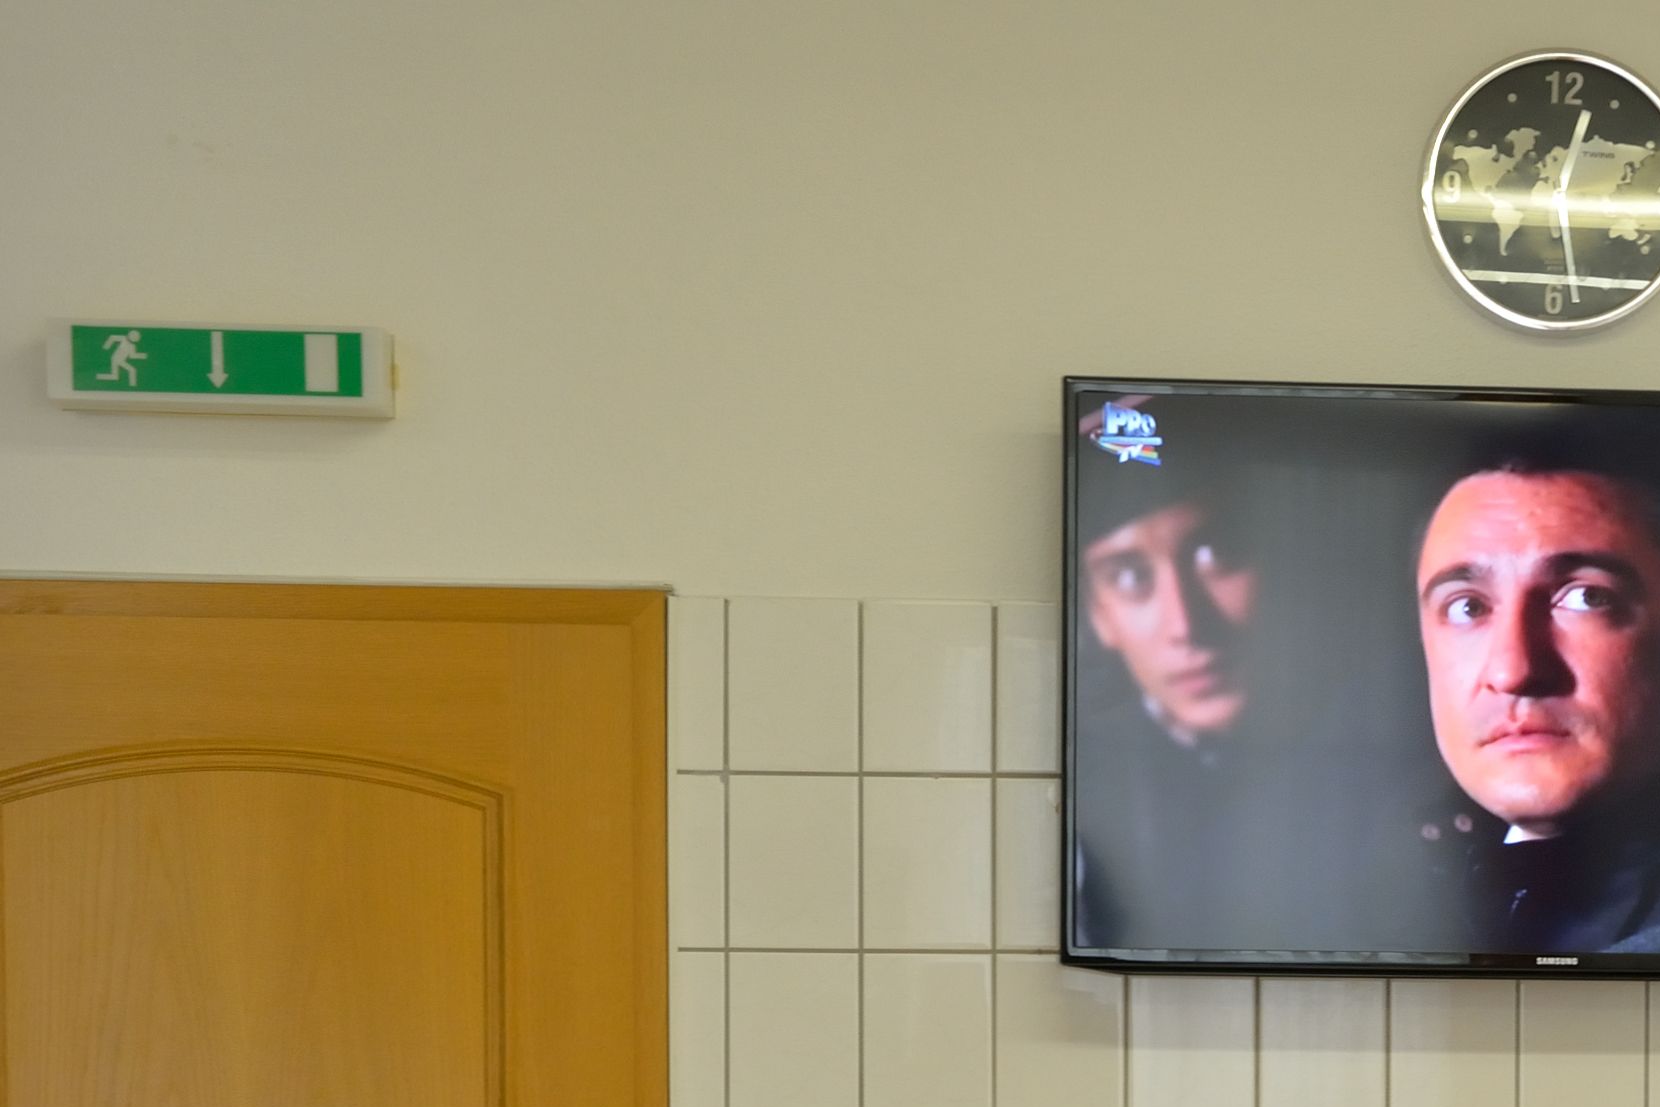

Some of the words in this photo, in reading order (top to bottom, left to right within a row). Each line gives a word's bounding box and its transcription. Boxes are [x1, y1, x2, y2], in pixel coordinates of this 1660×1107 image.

[1545, 70, 1585, 106] 12
[1442, 170, 1462, 203] 9
[1545, 283, 1563, 315] 6
[1536, 957, 1579, 965] SAMSUNG
